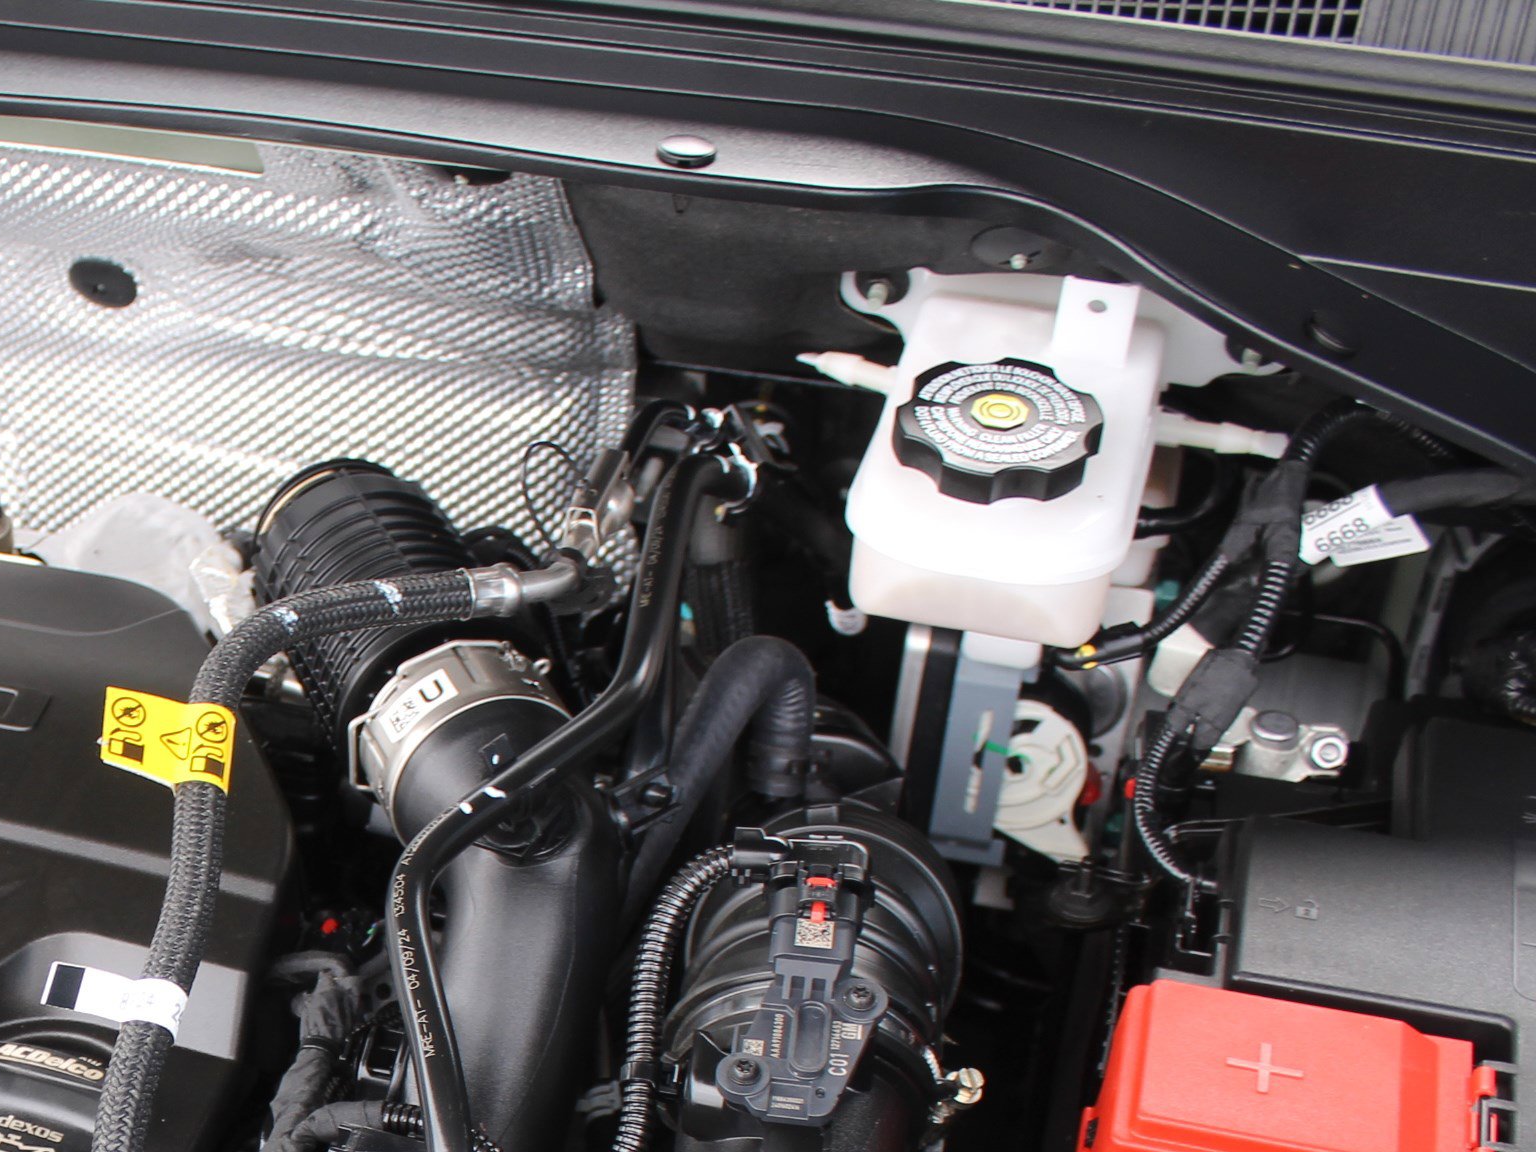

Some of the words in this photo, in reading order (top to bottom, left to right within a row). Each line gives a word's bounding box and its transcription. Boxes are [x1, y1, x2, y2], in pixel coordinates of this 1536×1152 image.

[1314, 517, 1370, 553] 6668
[418, 679, 444, 703] U
[398, 928, 421, 991] 04/09/24
[840, 1022, 863, 1041] GM
